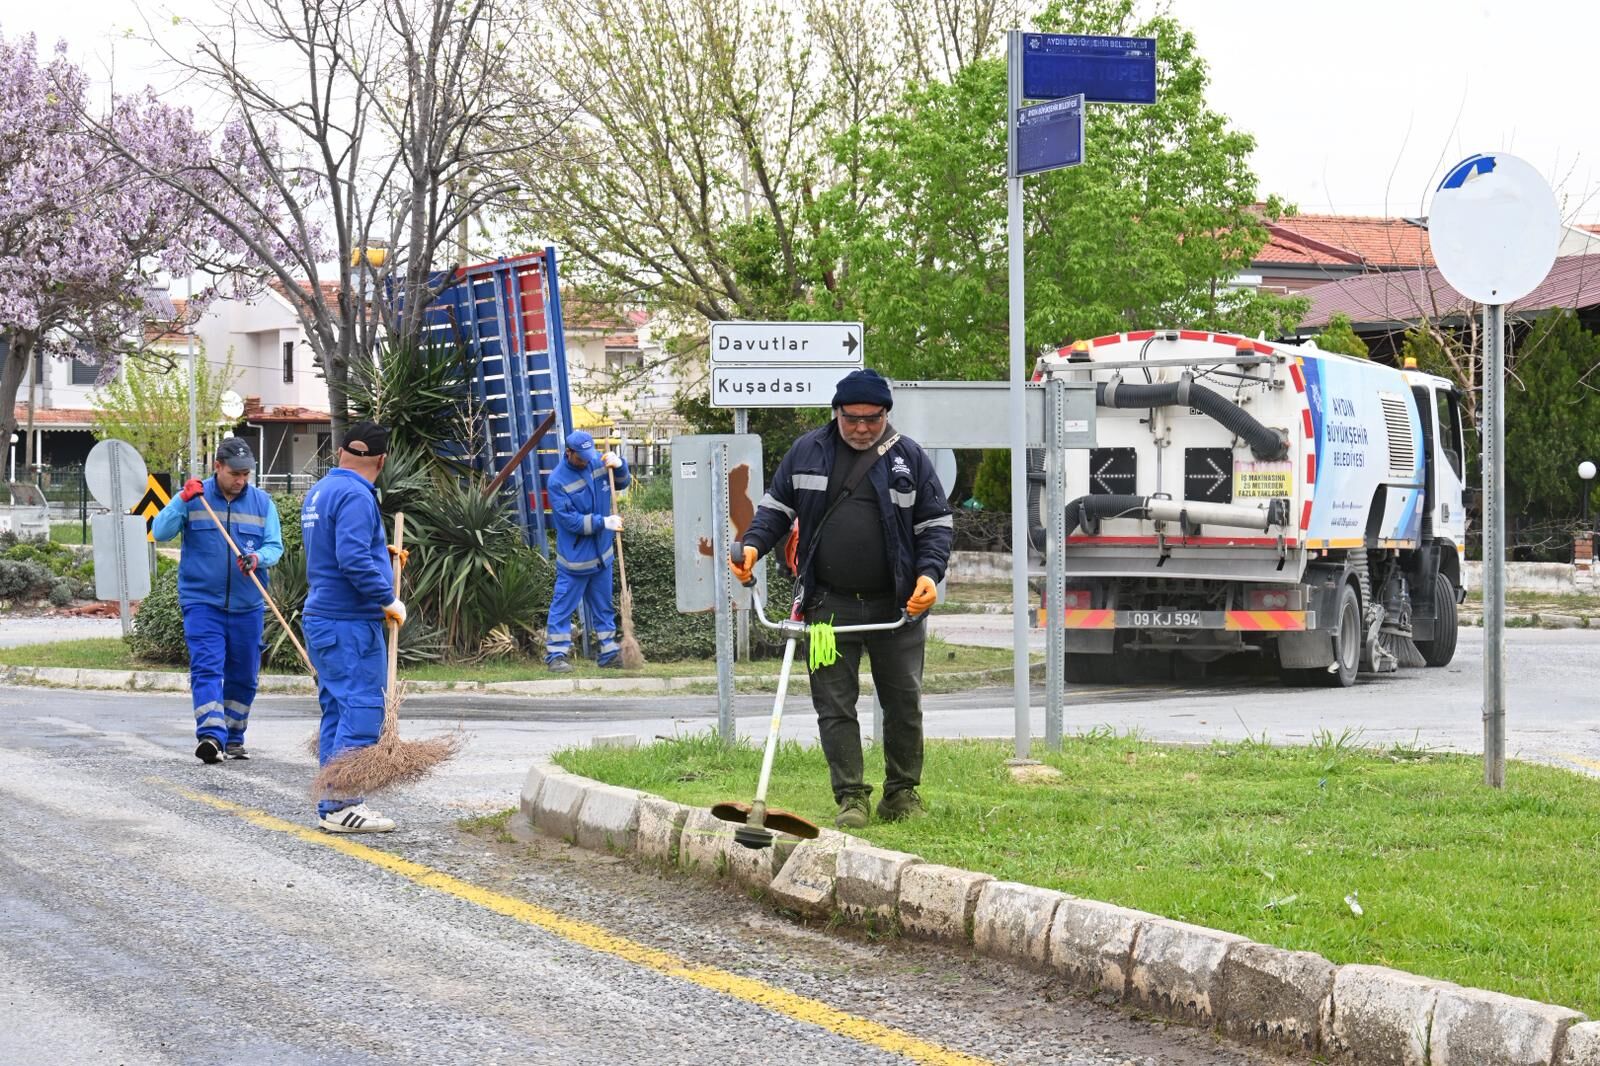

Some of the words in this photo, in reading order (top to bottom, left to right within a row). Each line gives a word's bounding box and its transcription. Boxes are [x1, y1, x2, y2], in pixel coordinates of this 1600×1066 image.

[719, 336, 809, 350] Davutlar
[718, 378, 812, 395] Kuşadası
[1332, 397, 1356, 418] AYDIN
[1327, 421, 1369, 449] BÜYÜKŞEHİR
[1333, 450, 1365, 468] BELEDİYESİ
[1134, 613, 1149, 626] 09
[1153, 613, 1172, 626] KJ
[1175, 613, 1199, 626] 594
